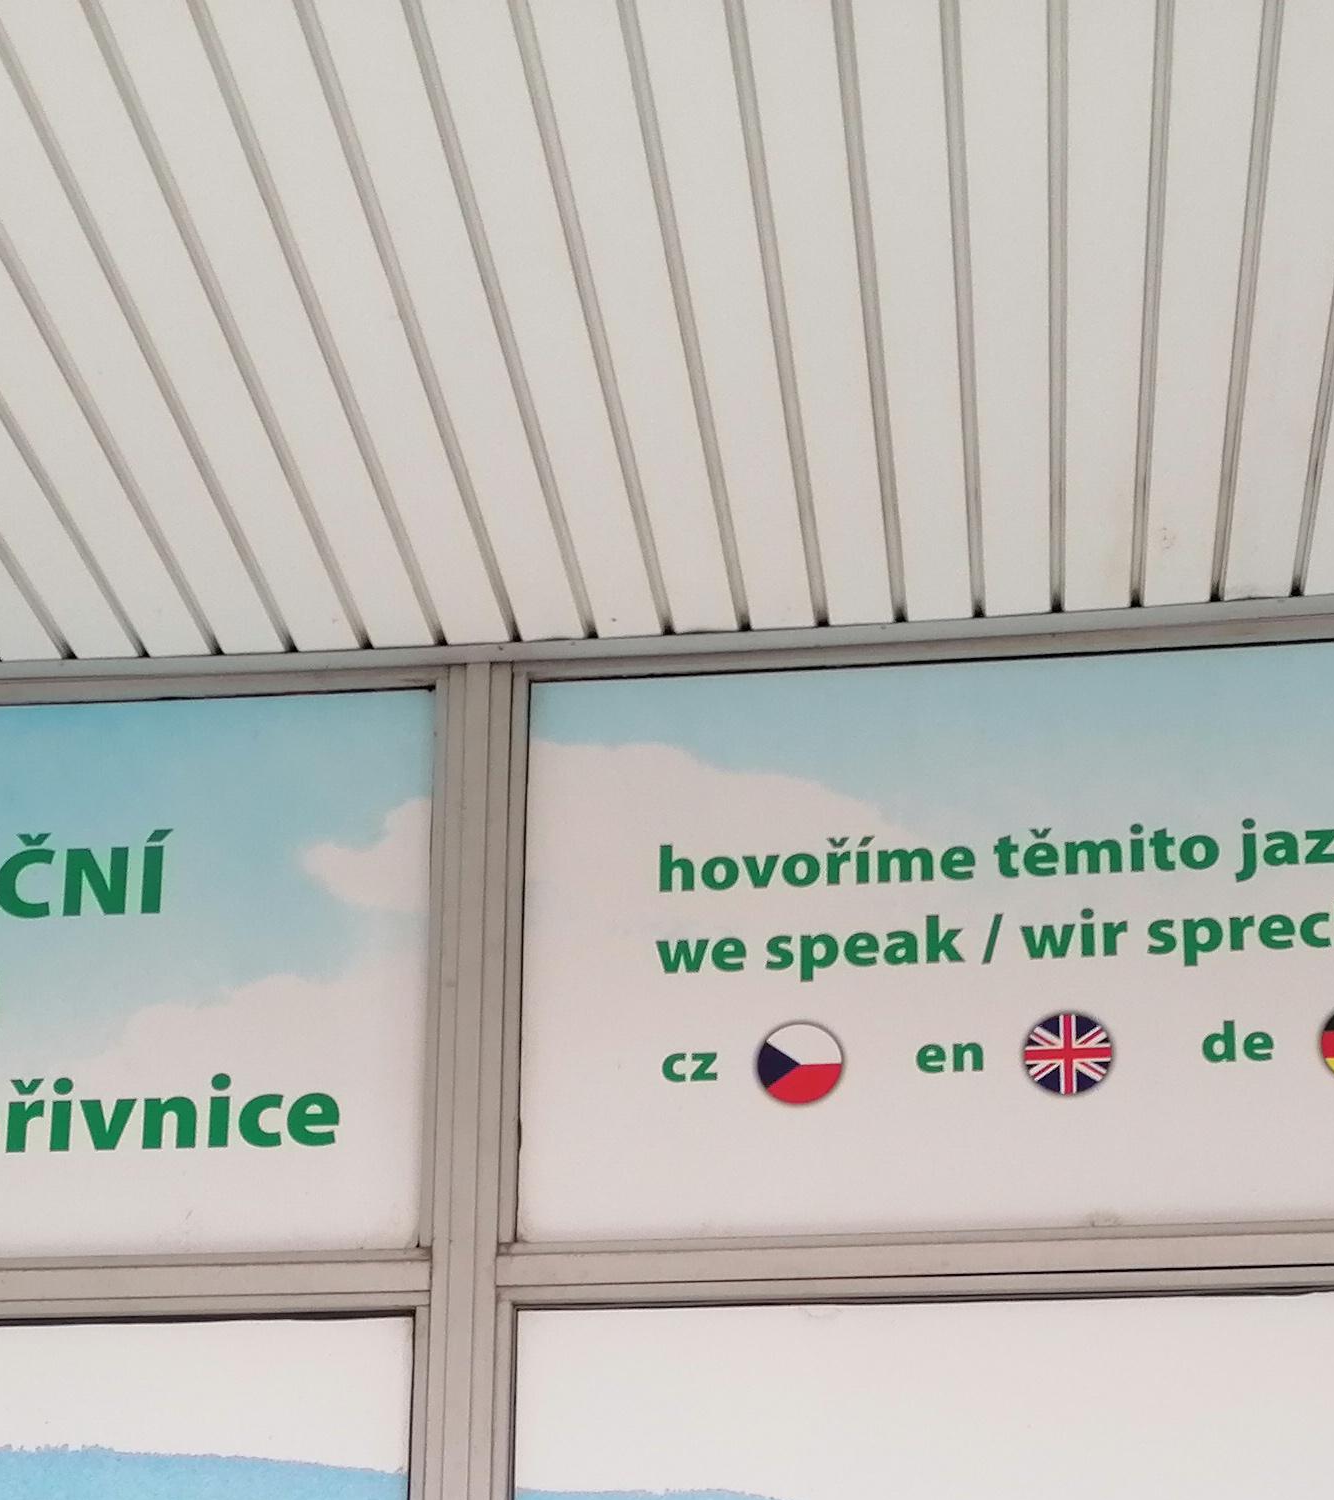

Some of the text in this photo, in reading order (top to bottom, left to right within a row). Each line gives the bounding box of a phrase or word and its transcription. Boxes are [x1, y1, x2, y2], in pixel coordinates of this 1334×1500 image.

[658, 834, 976, 892] hovoříme
[993, 823, 1221, 878] těmito
[656, 935, 747, 974] we
[765, 914, 965, 982] speak
[981, 913, 1004, 965] /
[1020, 908, 1129, 959] wir
[662, 1050, 718, 1083] cz
[915, 1040, 984, 1074] en
[1201, 1020, 1275, 1063] de
